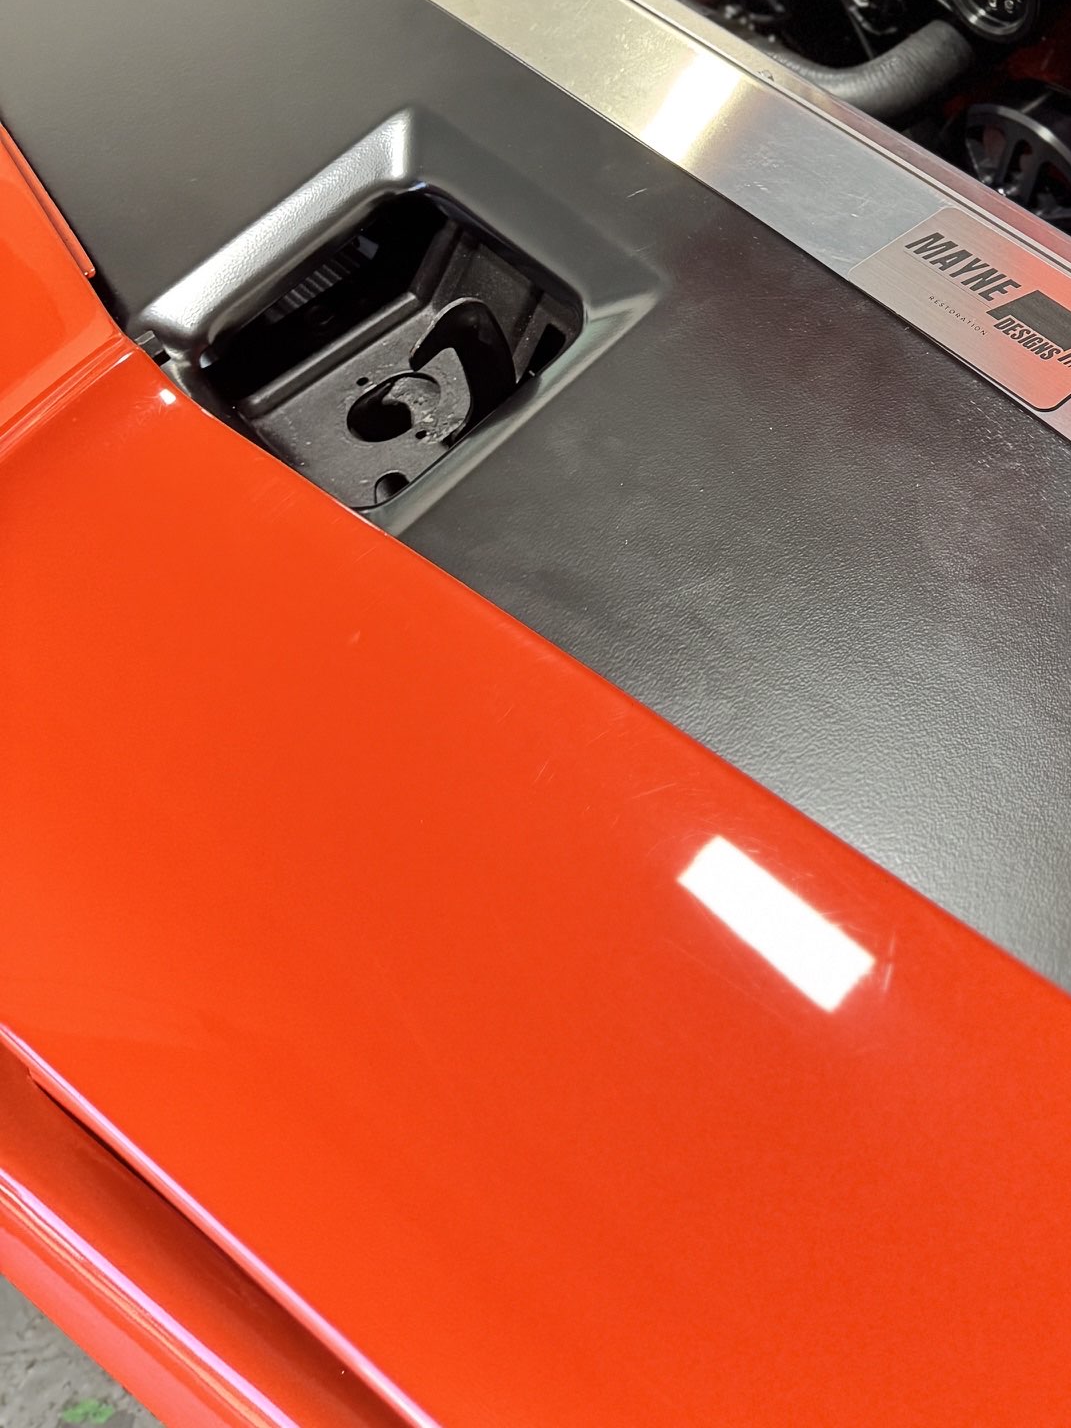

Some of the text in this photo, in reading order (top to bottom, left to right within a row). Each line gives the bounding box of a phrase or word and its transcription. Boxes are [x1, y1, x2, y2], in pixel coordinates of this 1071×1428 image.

[904, 232, 1021, 301] MAYNE
[928, 295, 988, 336] RESTORATION
[994, 316, 1061, 361] DESIGNS
